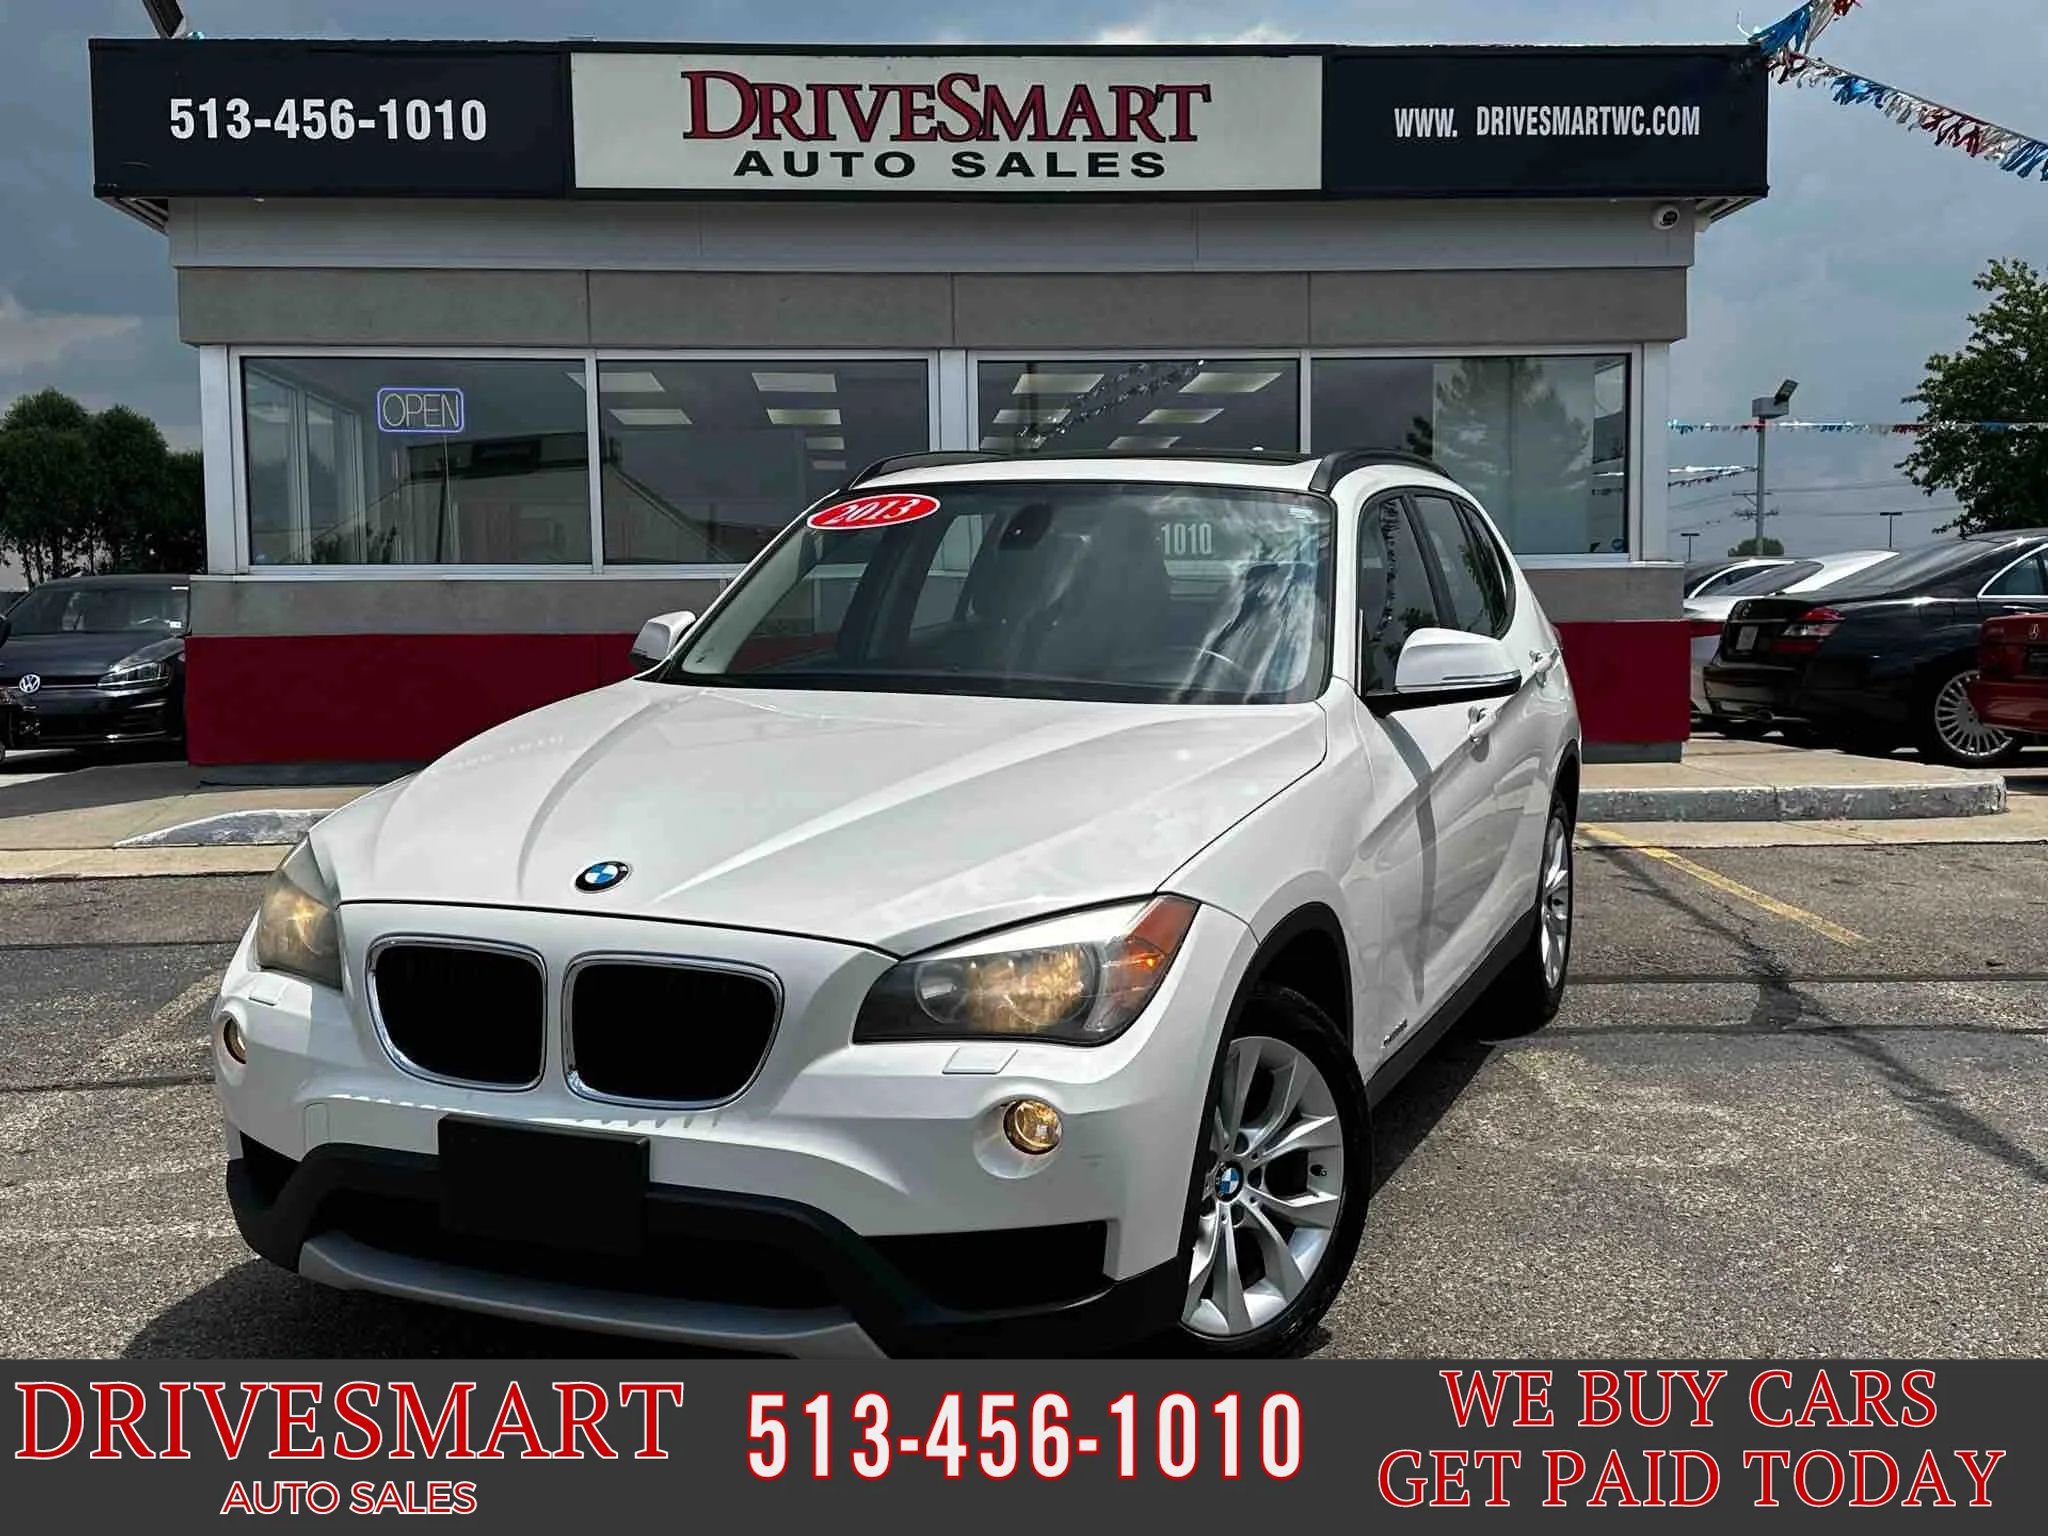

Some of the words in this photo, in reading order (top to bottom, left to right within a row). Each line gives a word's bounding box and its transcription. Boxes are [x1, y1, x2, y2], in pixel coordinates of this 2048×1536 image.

[169, 97, 488, 141] 513-456-1010
[1394, 107, 1458, 138] WWW.
[1476, 105, 1700, 136] DRIVESMARTWC.COM
[733, 150, 916, 178] AUTO
[951, 151, 1167, 178] SALES
[382, 392, 460, 428] OPEN
[820, 498, 920, 525] 2013
